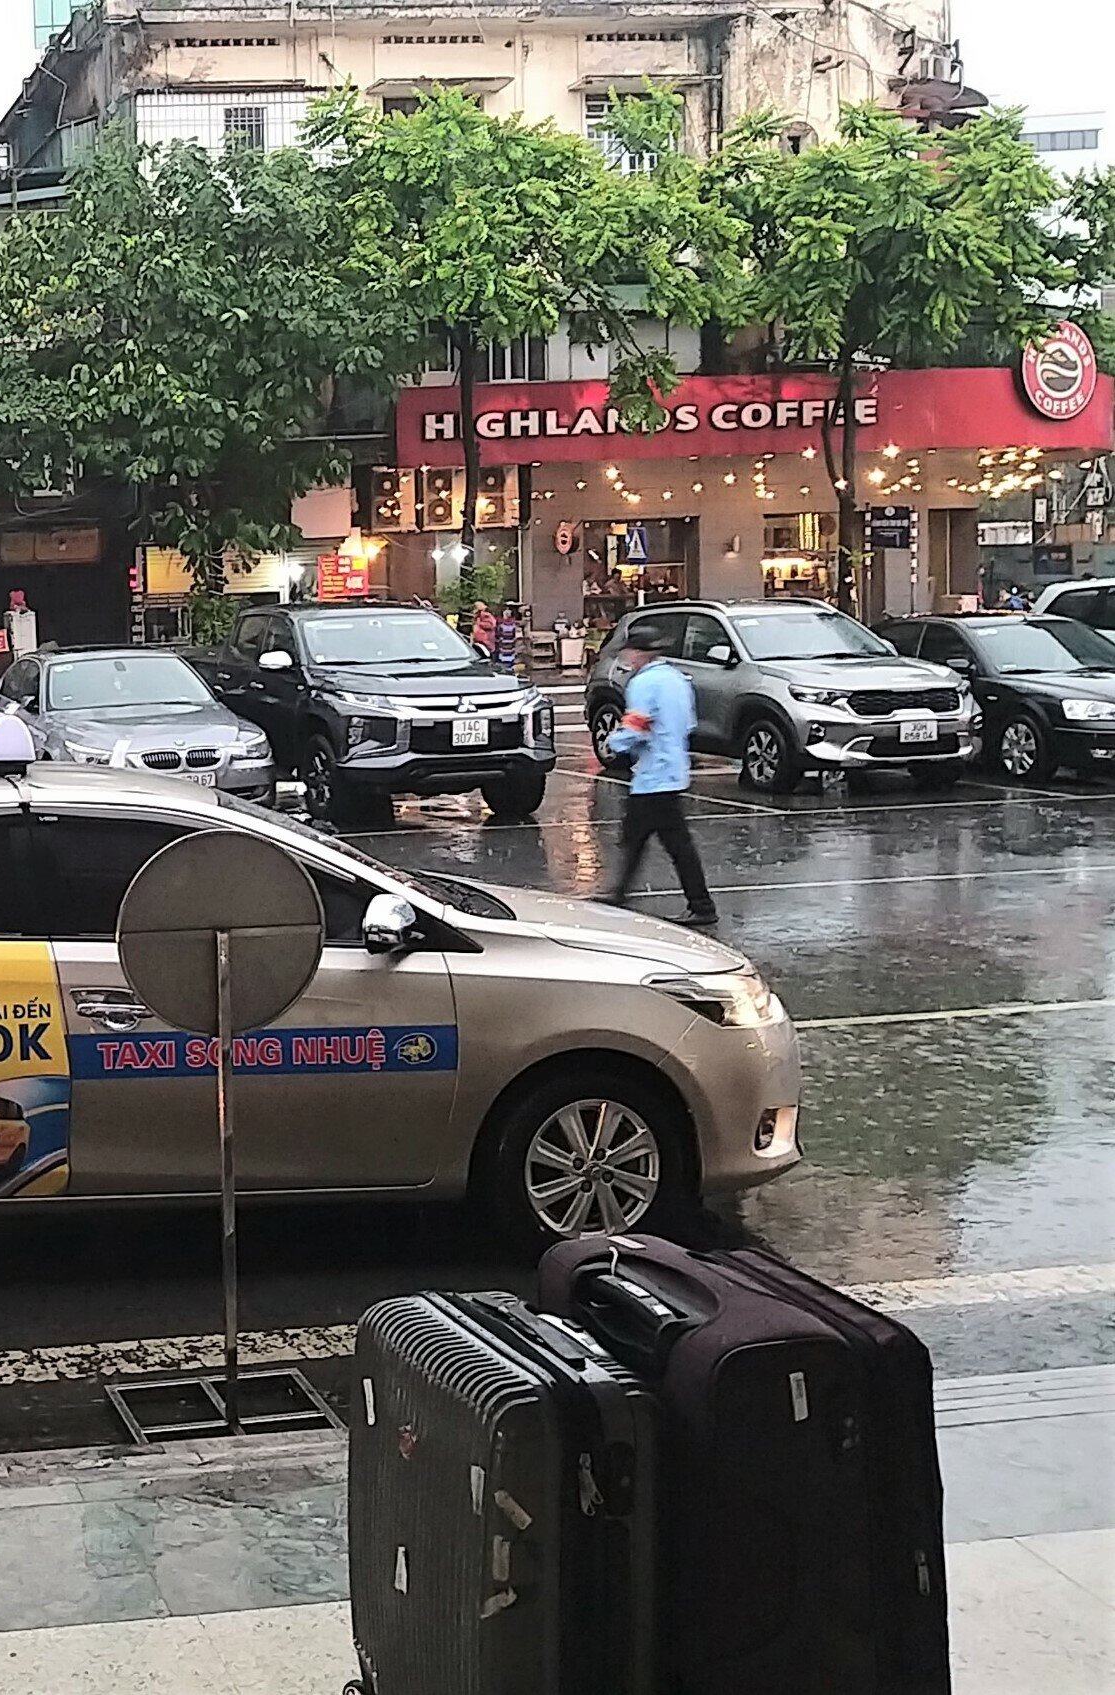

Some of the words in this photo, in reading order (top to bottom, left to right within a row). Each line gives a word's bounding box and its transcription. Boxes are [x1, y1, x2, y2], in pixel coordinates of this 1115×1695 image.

[1034, 389, 1085, 414] COFFEE
[424, 404, 699, 440] HGHLANDS
[12, 996, 51, 1020] ĐẾN
[97, 1040, 176, 1070] TAXI
[292, 1028, 386, 1071] NHUỆ
